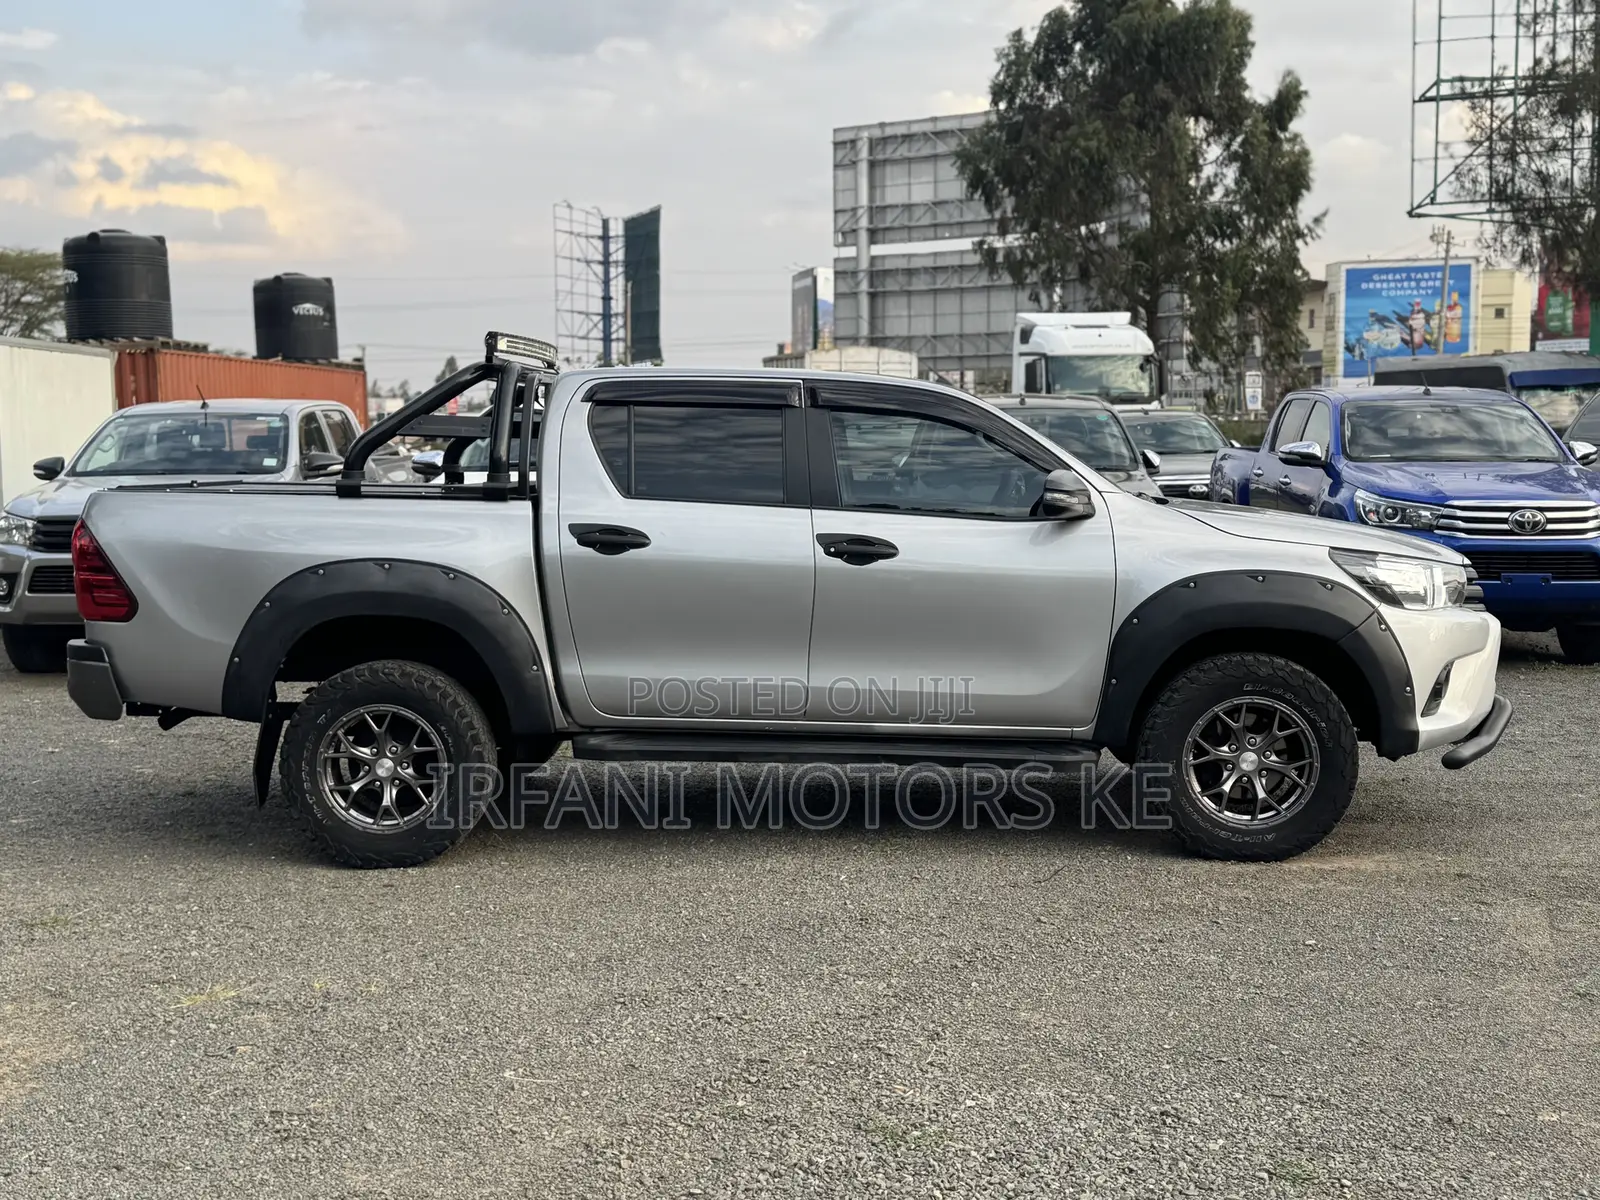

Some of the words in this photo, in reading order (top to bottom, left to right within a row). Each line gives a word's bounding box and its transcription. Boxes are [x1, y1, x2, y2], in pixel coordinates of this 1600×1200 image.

[1372, 273, 1407, 281] GREAT
[1410, 271, 1443, 280] TASTE
[1360, 281, 1417, 290] DESERVES
[1420, 279, 1455, 288] GRET
[1381, 289, 1433, 297] COMPANY
